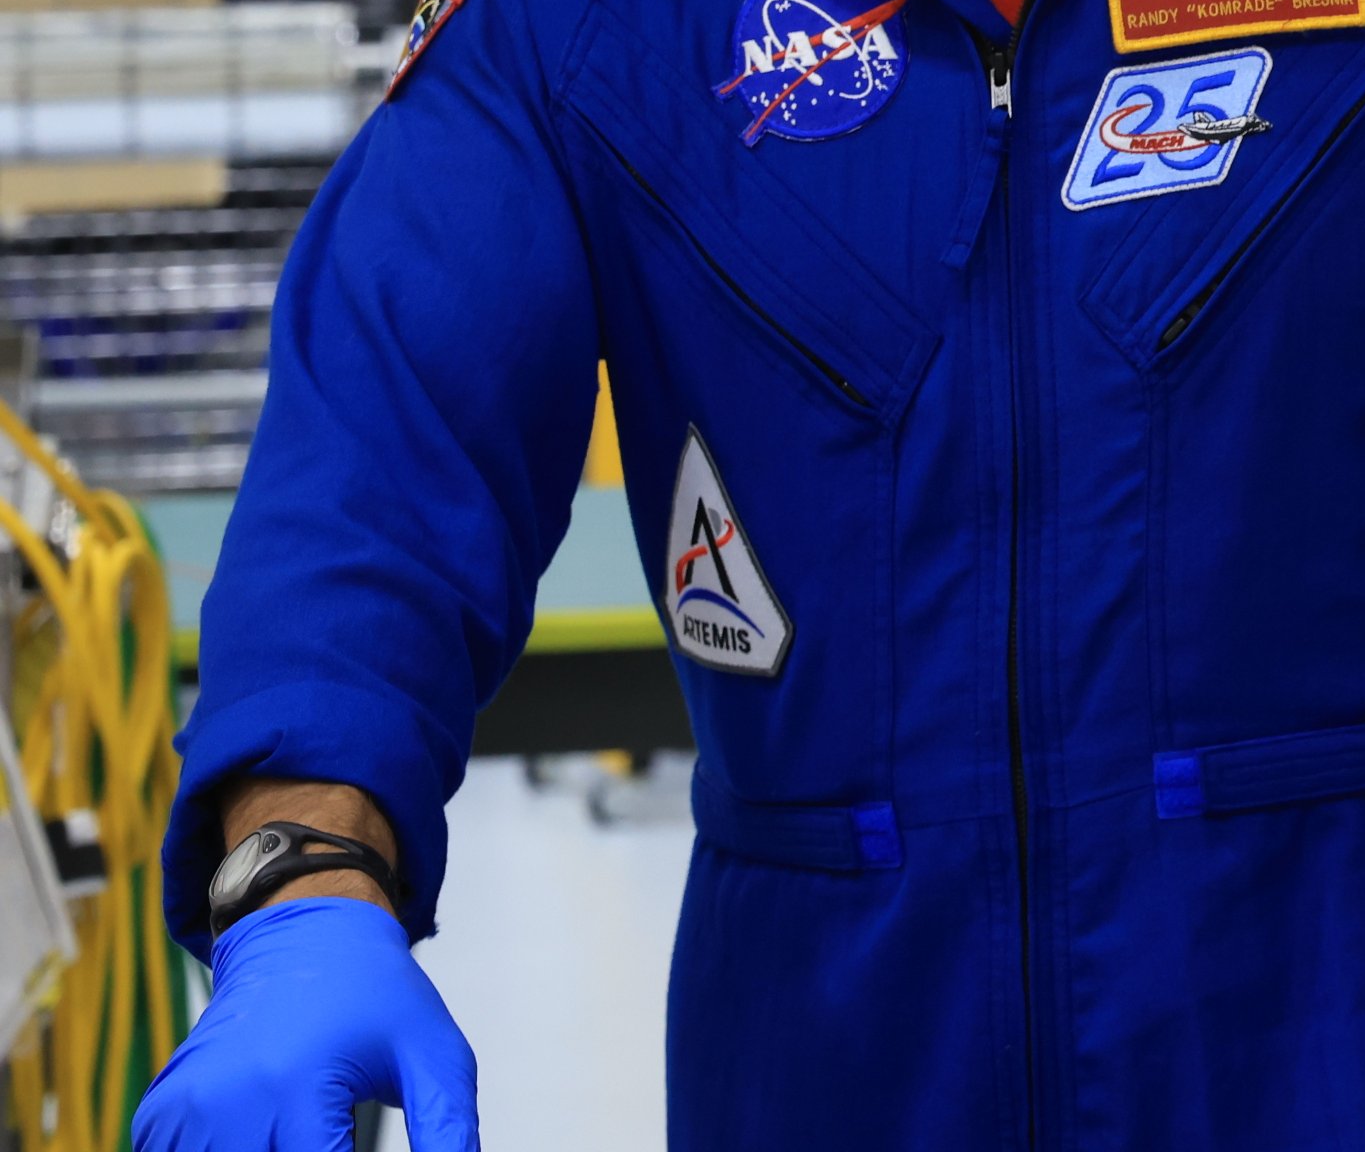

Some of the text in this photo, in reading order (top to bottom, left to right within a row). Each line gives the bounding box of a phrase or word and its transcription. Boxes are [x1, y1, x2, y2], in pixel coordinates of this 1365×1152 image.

[1127, 7, 1178, 29] RANDY
[742, 24, 898, 77] NASA
[1091, 70, 1236, 188] 25
[1130, 135, 1185, 149] MACH
[683, 613, 751, 654] ARTEMIS
